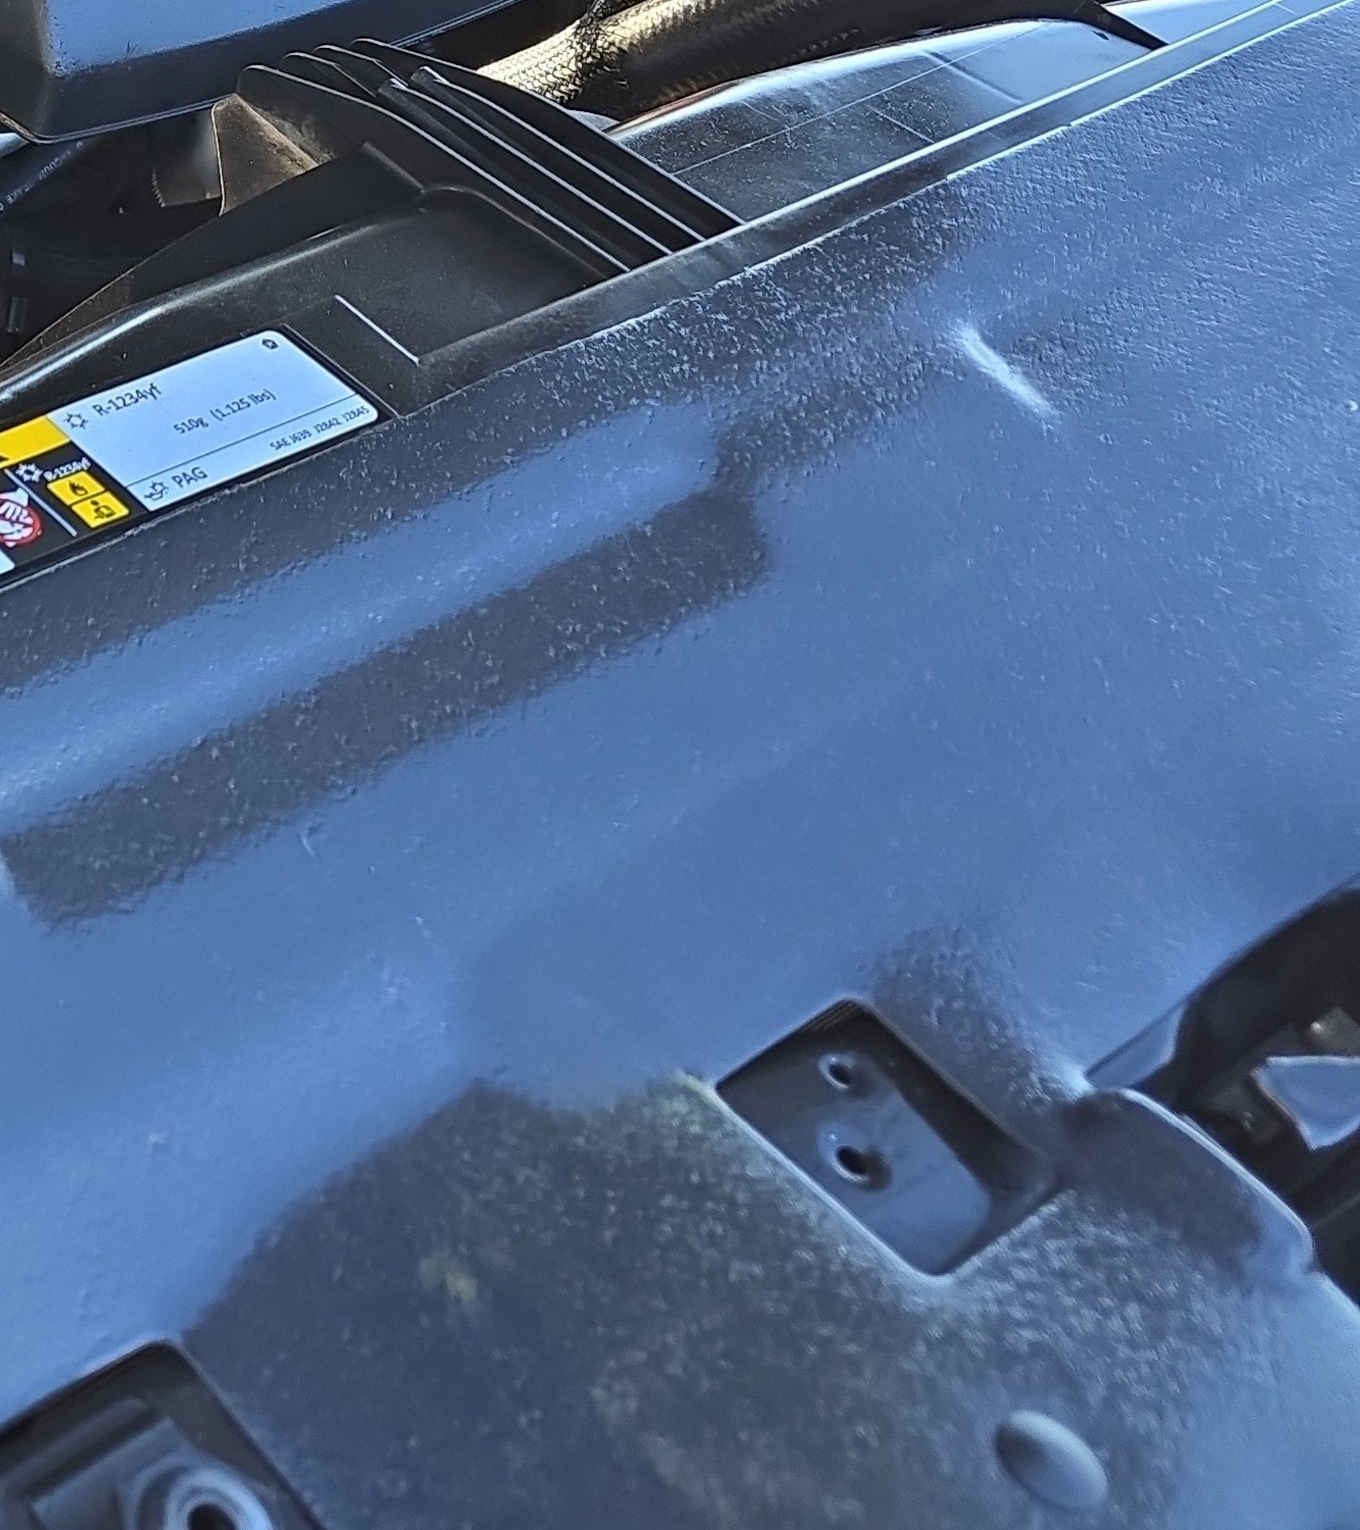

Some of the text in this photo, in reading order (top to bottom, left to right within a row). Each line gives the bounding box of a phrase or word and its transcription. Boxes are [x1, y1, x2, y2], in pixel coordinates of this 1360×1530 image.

[92, 382, 162, 417] R-1234yf
[209, 397, 251, 422] (1.125
[247, 388, 277, 405] lbs)
[43, 456, 92, 482] R-1234yf
[171, 466, 208, 488] PAG
